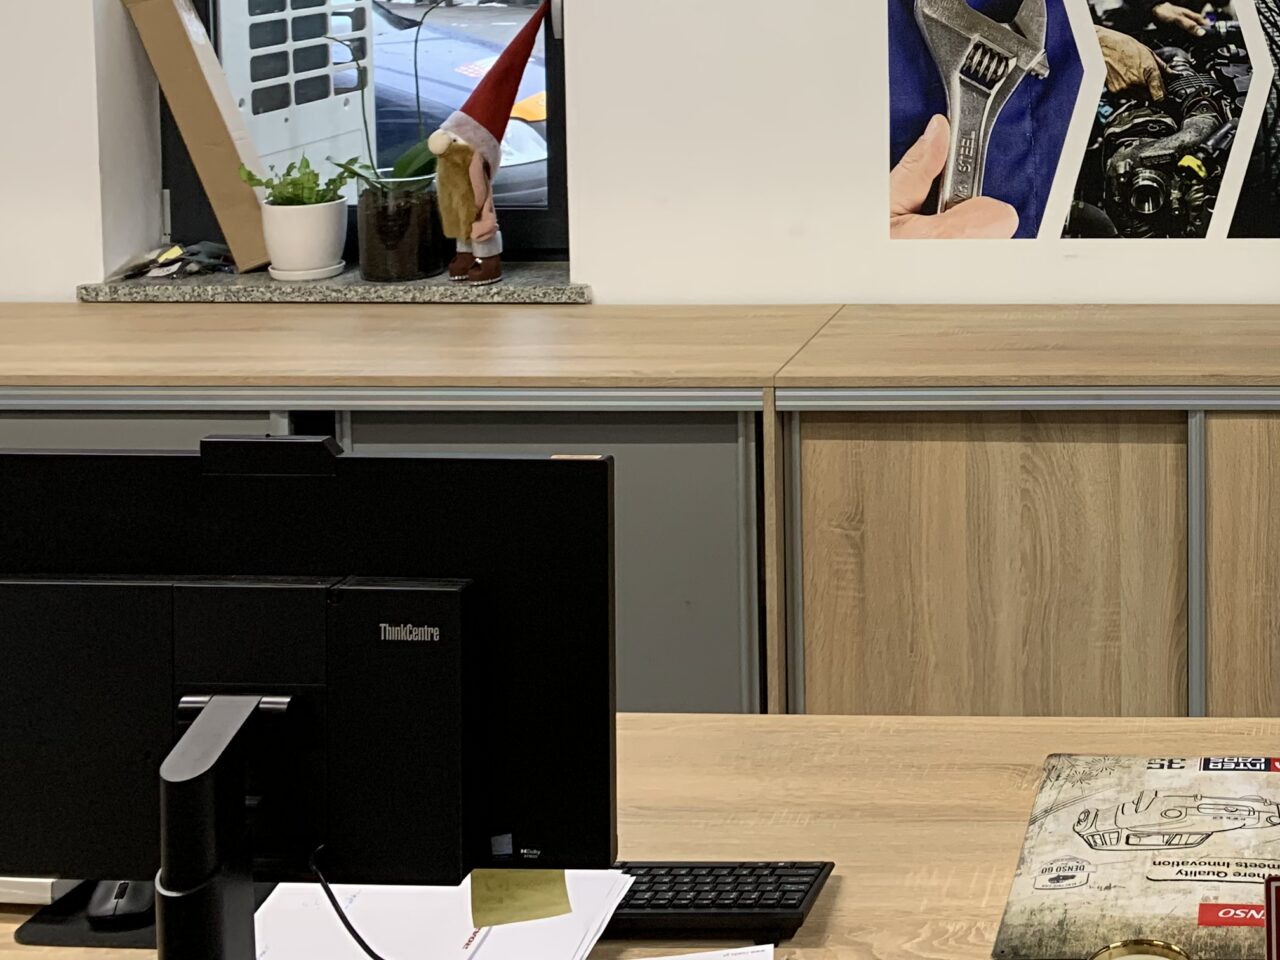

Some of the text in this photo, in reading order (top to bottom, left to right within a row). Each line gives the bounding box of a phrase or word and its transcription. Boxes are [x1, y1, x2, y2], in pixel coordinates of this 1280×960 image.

[958, 130, 977, 173] STEEL
[379, 623, 440, 642] ThinkCentre
[1209, 762, 1265, 771] INTER
[1041, 864, 1086, 874] DENSO GO
[1152, 860, 1280, 870] meets Innovation
[1175, 869, 1278, 880] here Quality
[1218, 908, 1264, 919] NSO
